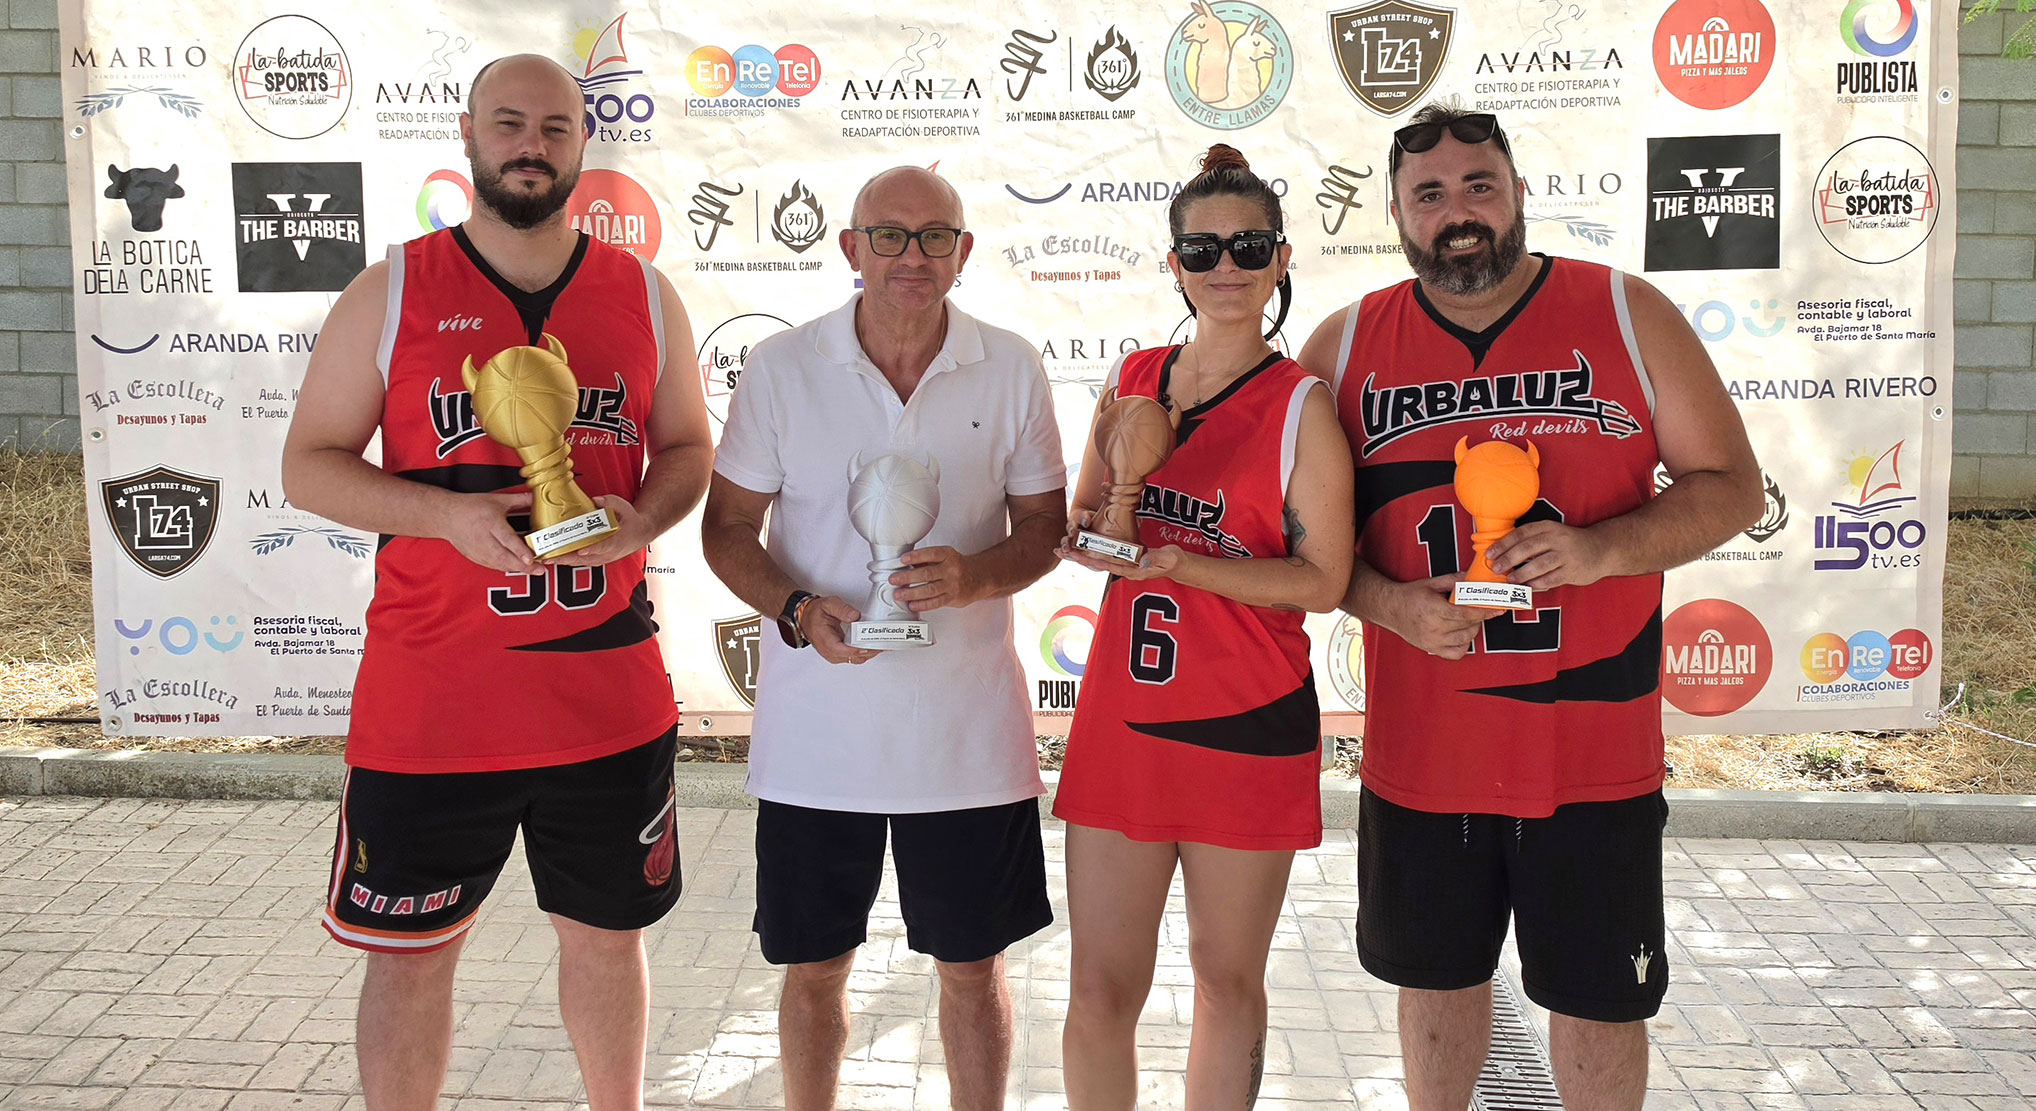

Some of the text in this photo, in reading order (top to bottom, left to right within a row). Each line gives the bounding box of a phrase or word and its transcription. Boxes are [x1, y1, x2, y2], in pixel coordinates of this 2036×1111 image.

[1351, 13, 1434, 28] URBAN STREET SHOP
[1669, 31, 1761, 66] MADARI
[71, 46, 206, 68] MARIO
[277, 47, 337, 71] batida
[1476, 48, 1624, 75] AVANZA
[1681, 67, 1700, 77] PIZZA
[1702, 67, 1707, 76] Y
[1837, 61, 1918, 94] PUBLISTA
[264, 72, 329, 92] SPORTS
[842, 78, 982, 101] AVANZA
[1475, 79, 1621, 94] CENTRO DE FISIOTERAPIA Y
[689, 98, 801, 109] COLABORACIONES
[1476, 95, 1621, 111] READAPTACIÓN DEPORTIVA
[1878, 94, 1918, 103] INTELIGENTE
[376, 112, 429, 122] CENTRO DE
[689, 109, 765, 118] CLUBES DEPORTIVOS
[841, 109, 980, 120] CENTRO DE FISIOTERAPIA Y
[1025, 109, 1136, 122] MEDINA BASKETBALL CAMP
[1183, 94, 1276, 126] ENTRE LLAMAS
[379, 127, 450, 140] READAPTACIÓN
[599, 125, 652, 142] tv.es
[842, 124, 980, 138] READAPTACIÓN DEPORTIVA
[1523, 172, 1622, 196] ARIO
[1860, 168, 1925, 192] batida
[1080, 181, 1183, 203] ARANDA
[1653, 194, 1775, 222] THE BARBER
[1845, 194, 1913, 216] SPORTS
[240, 219, 361, 243] THE BARBER
[92, 240, 203, 266] LA BOTICA
[1002, 234, 1141, 269] La Escollera
[1340, 244, 1375, 255] MEDINA
[713, 261, 823, 272] MEDINA BASKETBALL CAMP
[84, 269, 213, 294] DELA CARNE
[1031, 269, 1121, 283] Desayunos y Tapas
[1797, 298, 1893, 310] Asesoria fiscal,
[1797, 308, 1912, 321] contable y laboral
[1797, 324, 1882, 334] Avda. Bajamar 18
[1826, 333, 1858, 341] Puerto
[1860, 332, 1873, 340] de
[1875, 332, 1903, 340] Santa
[1905, 330, 1937, 339] María
[169, 333, 270, 353] ARANDA
[1042, 337, 1140, 359] ARIO
[85, 379, 225, 413] La Escollera
[1361, 348, 1598, 439] URBALUZ
[1728, 376, 1938, 401] ARANDA RIVERO
[117, 413, 207, 426] Desayunos y Tapas
[256, 406, 289, 419] Puerto
[1489, 419, 1590, 441] Red devils
[122, 482, 201, 496] URBAN STREET SHOP
[543, 522, 584, 541] Clasificado
[1158, 526, 1181, 542] Red
[1813, 514, 1927, 571] 11500
[1704, 551, 1757, 561] BASKETBALL
[1759, 550, 1784, 561] CAMP
[1871, 553, 1921, 569] tv.es
[1466, 587, 1509, 596] Clasificado
[253, 615, 343, 627] Asesoria fiscal,
[253, 625, 362, 636] contable y laboral
[1128, 591, 1180, 686] 6
[254, 639, 335, 648] Avda. Bajamar 18
[282, 647, 314, 655] Puerto
[315, 647, 328, 655] de
[329, 647, 355, 655] Santa
[1665, 644, 1757, 674] MADARI
[1677, 676, 1744, 685] PIZZA Y MAS JALEOS
[1802, 680, 1910, 695] COLABORACIONES
[104, 678, 239, 711] La Escollera
[1801, 692, 1876, 703] CLUBES DEPORTIVOS
[133, 711, 220, 725] Desayunos y Tapas
[271, 704, 304, 716] Puerto
[307, 704, 320, 716] de
[350, 882, 462, 916] MIAMI
